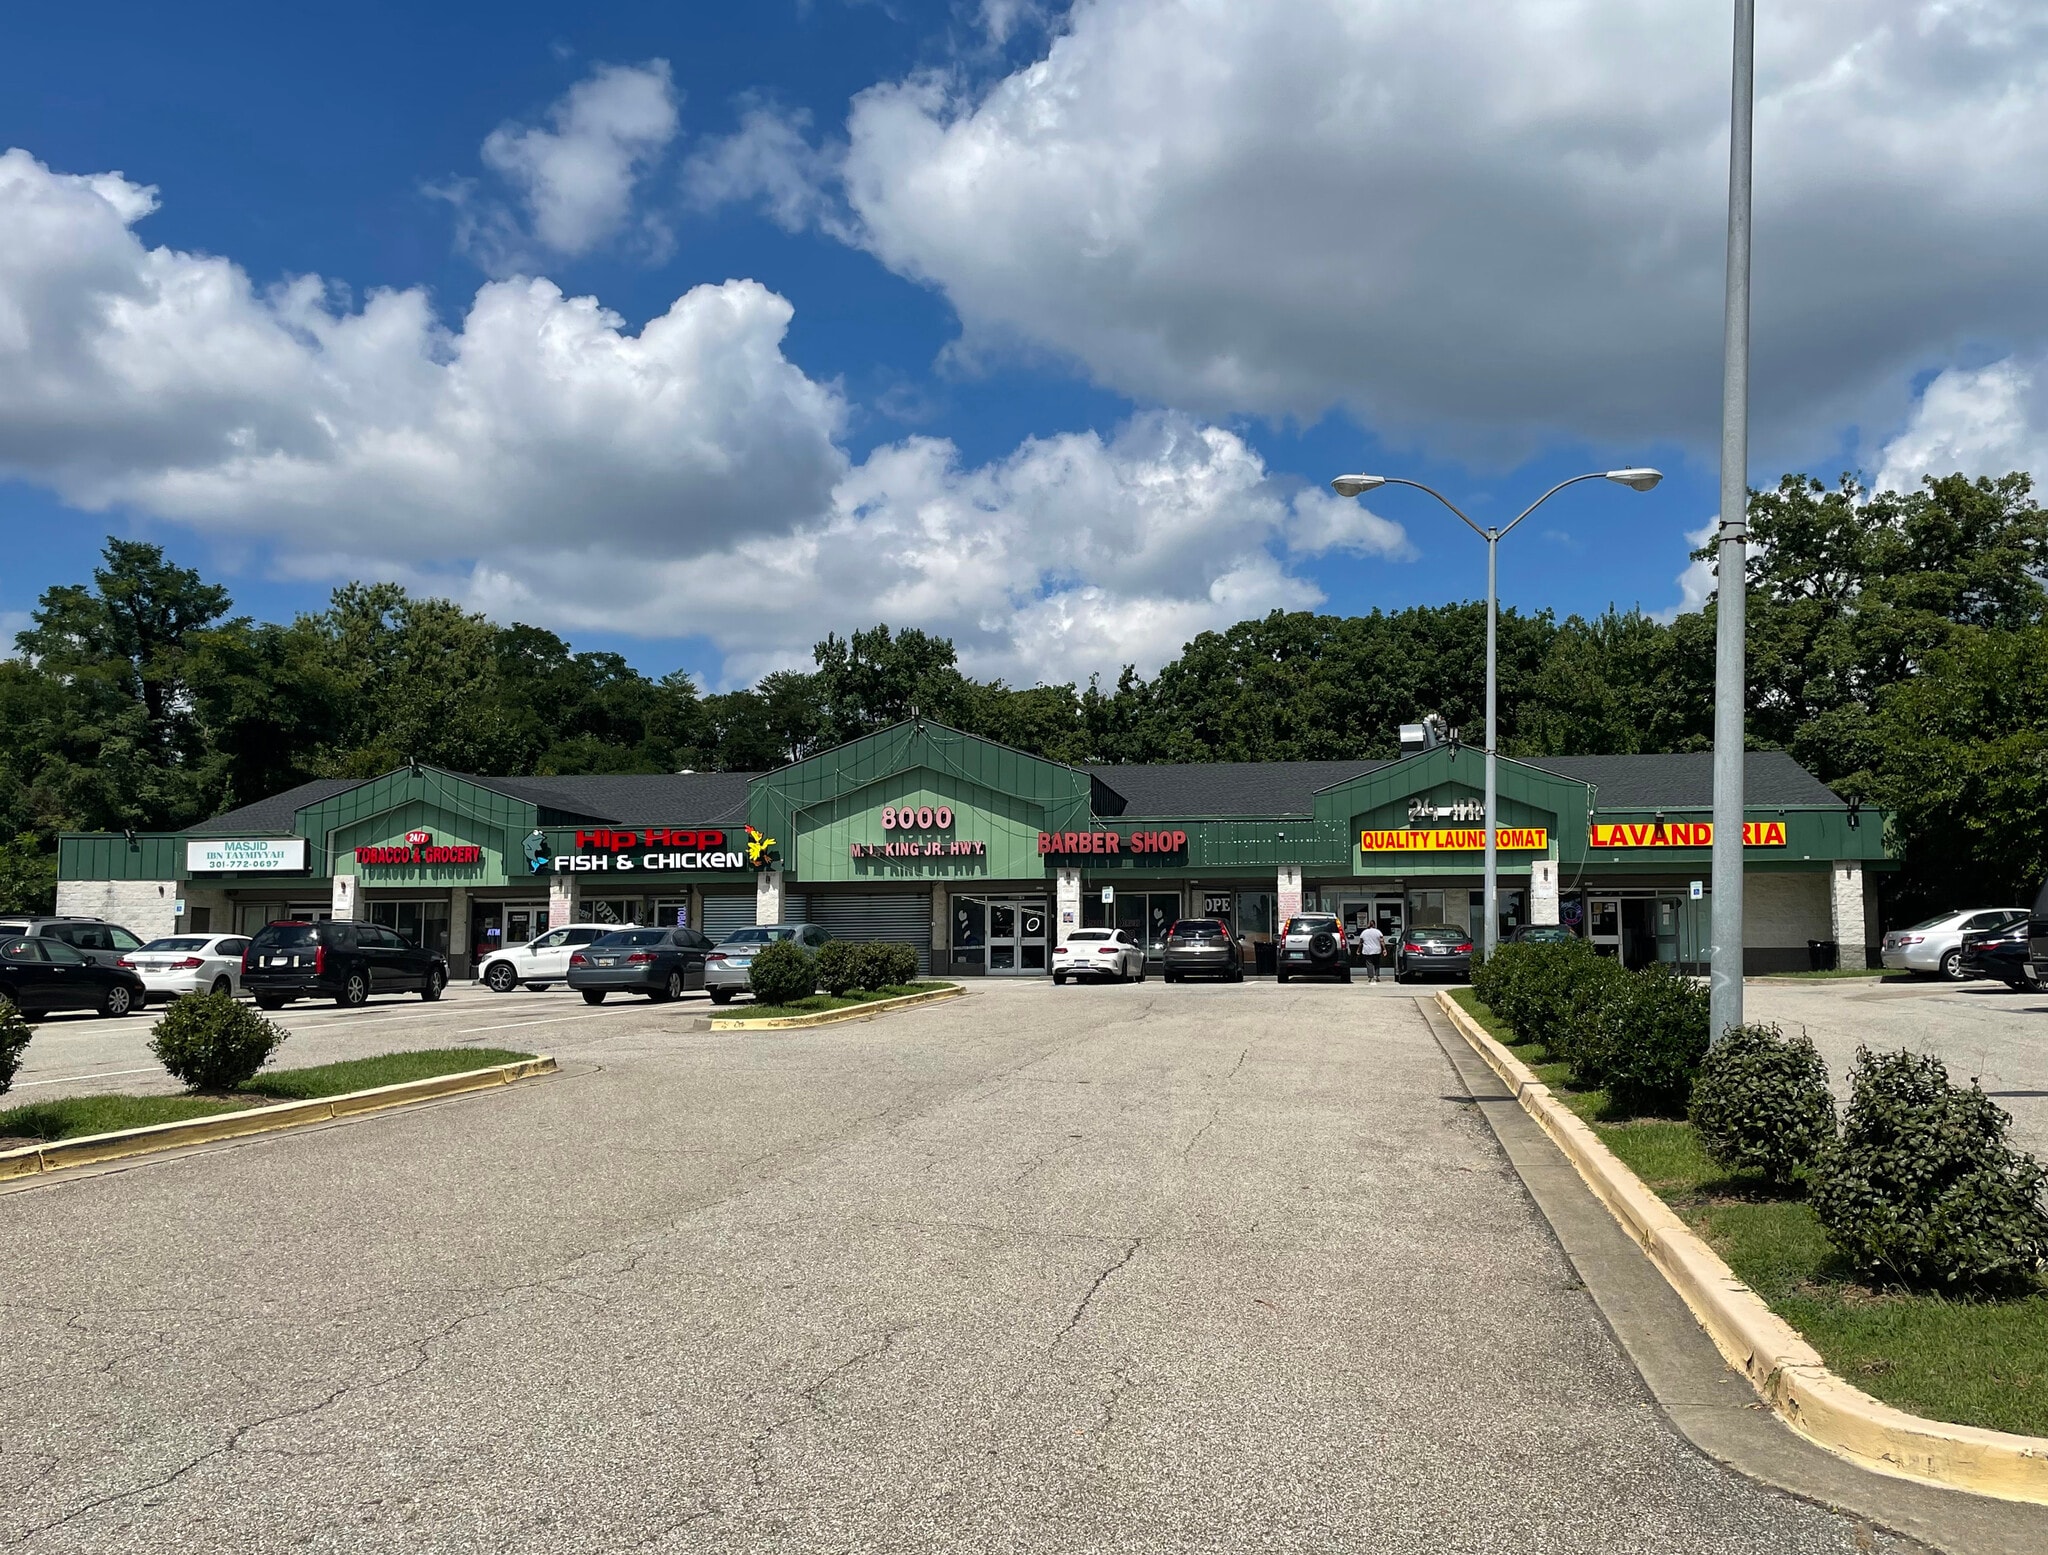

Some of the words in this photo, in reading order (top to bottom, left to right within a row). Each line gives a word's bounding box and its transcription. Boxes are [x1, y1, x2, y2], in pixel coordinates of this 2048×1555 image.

[881, 805, 952, 830] 8000
[409, 833, 427, 843] 24/7
[645, 828, 723, 851] Hop
[1038, 831, 1120, 854] BARBER
[1130, 830, 1187, 853] SHOP
[1363, 832, 1430, 850] QUALITY
[1591, 822, 1785, 846] LAVANDRIA
[224, 841, 268, 851] MASJID
[850, 843, 864, 858] M.
[885, 842, 919, 857] KING
[924, 841, 945, 856] JR.
[950, 840, 984, 856] HWY.
[207, 851, 223, 860] IBN
[226, 850, 285, 859] TAYMIYYAH
[355, 847, 411, 864] TOBACCO
[412, 848, 421, 864] &
[425, 846, 480, 863] GROCERY
[555, 855, 608, 871] FISH
[616, 855, 634, 870] &
[209, 860, 279, 869] 301-772-0697
[1205, 897, 1231, 912] OPE
[487, 928, 501, 936] ATM
